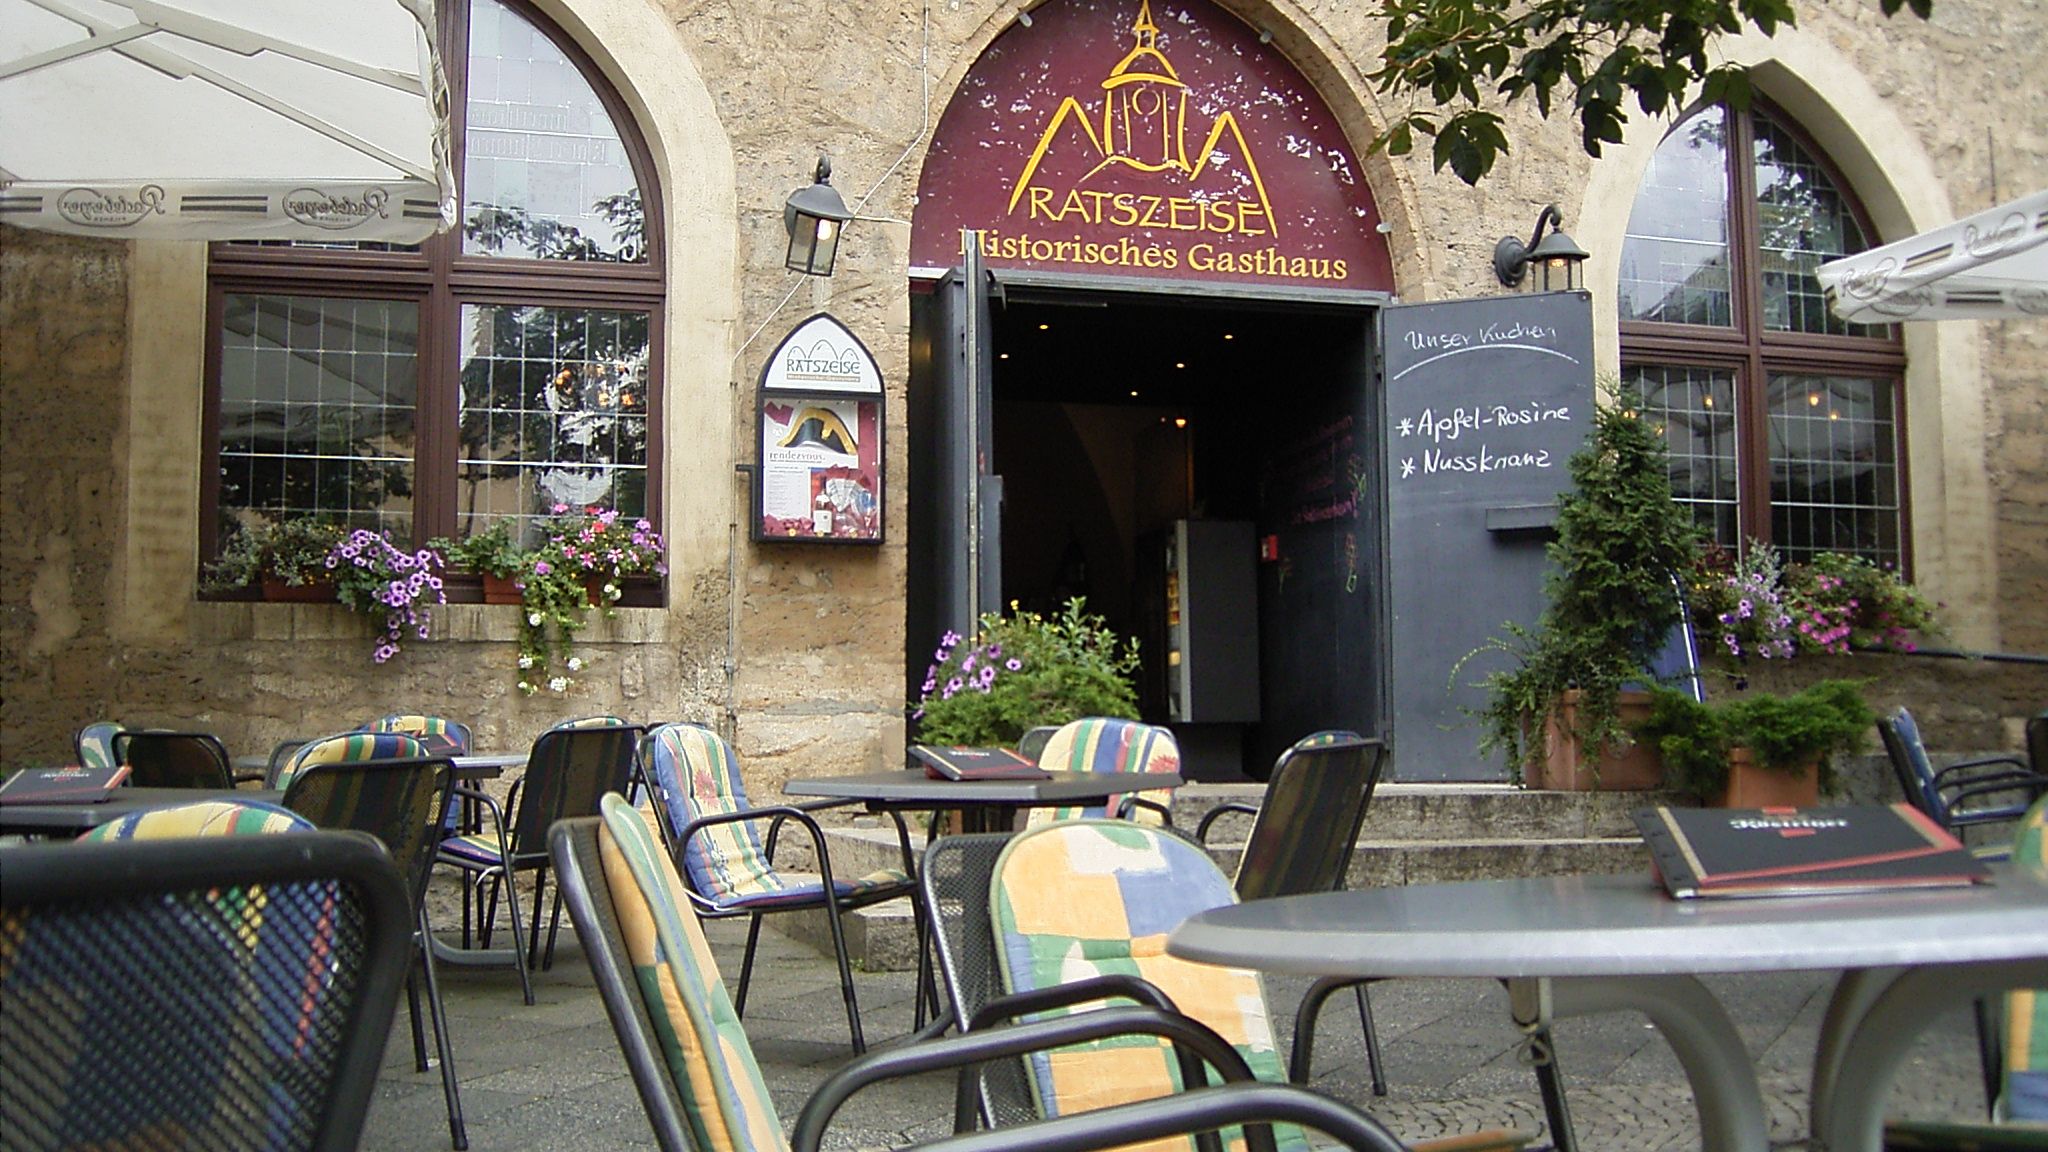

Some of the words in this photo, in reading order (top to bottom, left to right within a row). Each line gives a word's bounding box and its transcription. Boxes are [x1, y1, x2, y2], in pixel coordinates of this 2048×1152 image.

[1029, 186, 1267, 235] RATSZEISE
[957, 228, 1177, 269] Historisches
[1188, 243, 1348, 280] Gasthaus
[1404, 330, 1471, 350] Unser
[786, 357, 862, 375] RATSZEISE
[1416, 401, 1571, 443] Apfel-Rosine
[1423, 444, 1552, 474] Nusskranz
